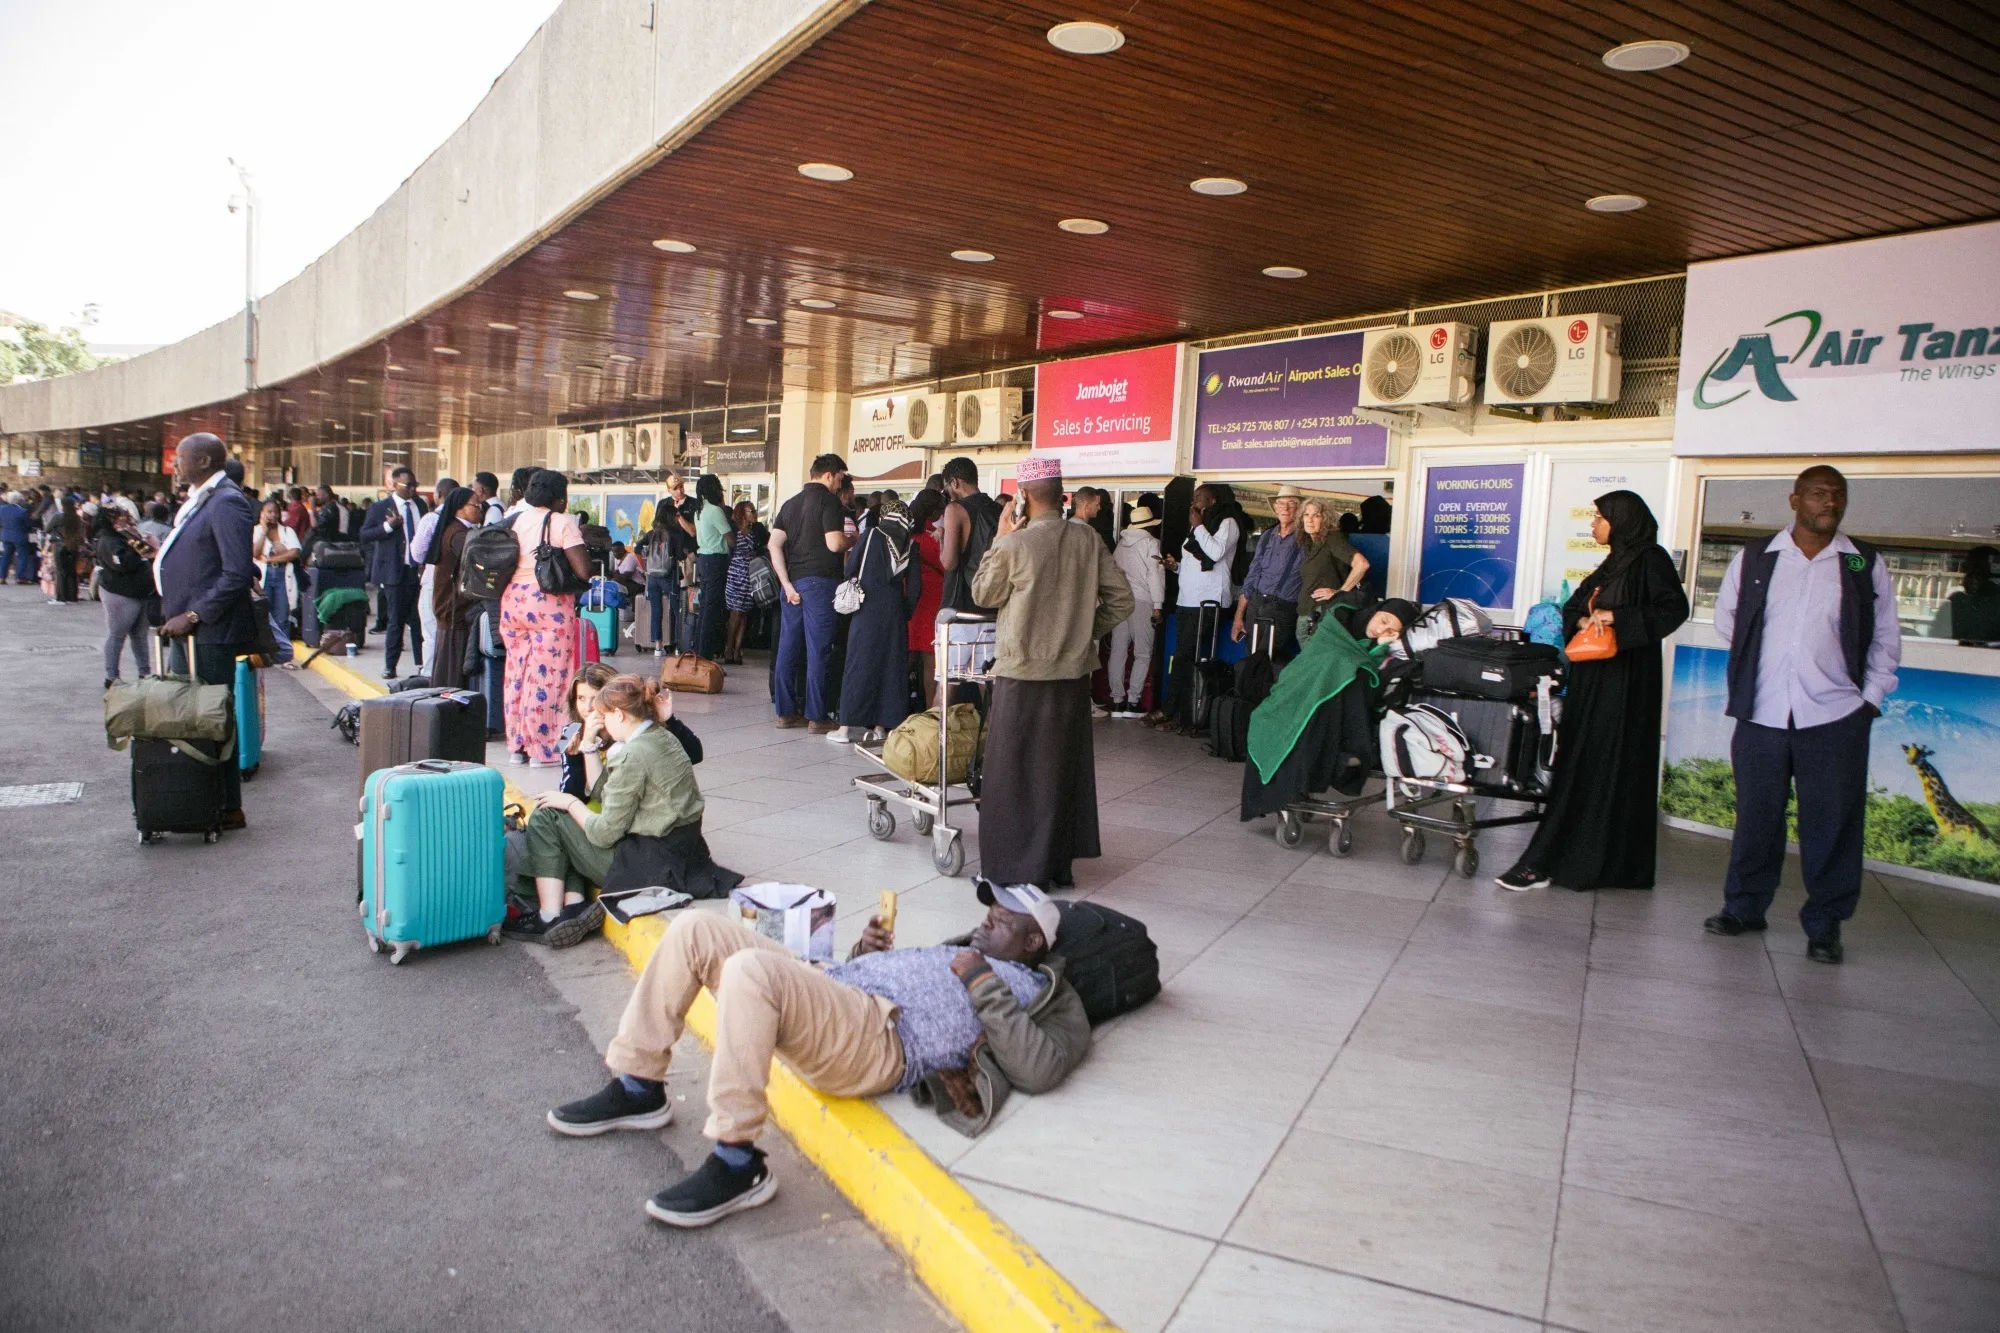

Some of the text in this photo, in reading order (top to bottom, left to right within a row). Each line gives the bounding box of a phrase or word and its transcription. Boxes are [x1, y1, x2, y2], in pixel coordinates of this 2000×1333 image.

[1568, 348, 1585, 360] LG
[1808, 329, 1883, 368] Air
[1430, 353, 1444, 364] LG
[1228, 372, 1284, 388] RwandAir
[1288, 367, 1323, 383] Airport
[1324, 365, 1350, 378] Sales
[1900, 363, 1996, 382] The Wings
[1076, 379, 1128, 403] Jambojet
[1053, 413, 1151, 436] Sales & Servicing
[1208, 422, 1241, 434] TEL:+254
[1242, 421, 1257, 432] 725
[1258, 420, 1273, 431] 706
[1274, 419, 1289, 430] 807
[1297, 417, 1318, 428] +254
[1319, 416, 1335, 427] 731
[1337, 415, 1353, 426] 300
[853, 437, 886, 453] AIRPORT
[1222, 435, 1352, 450] Email: sales.nairobi@rwandair.com
[716, 450, 765, 460] Domestic Departures
[1436, 478, 1514, 490] WORKING HOURS
[1438, 502, 1508, 512] OPEN EVERYDAY
[1434, 513, 1468, 523] 0300HRS
[1475, 513, 1511, 523] 1300HRS
[1434, 525, 1468, 534] 1700HRS
[1473, 525, 1510, 534] 2130HRS
